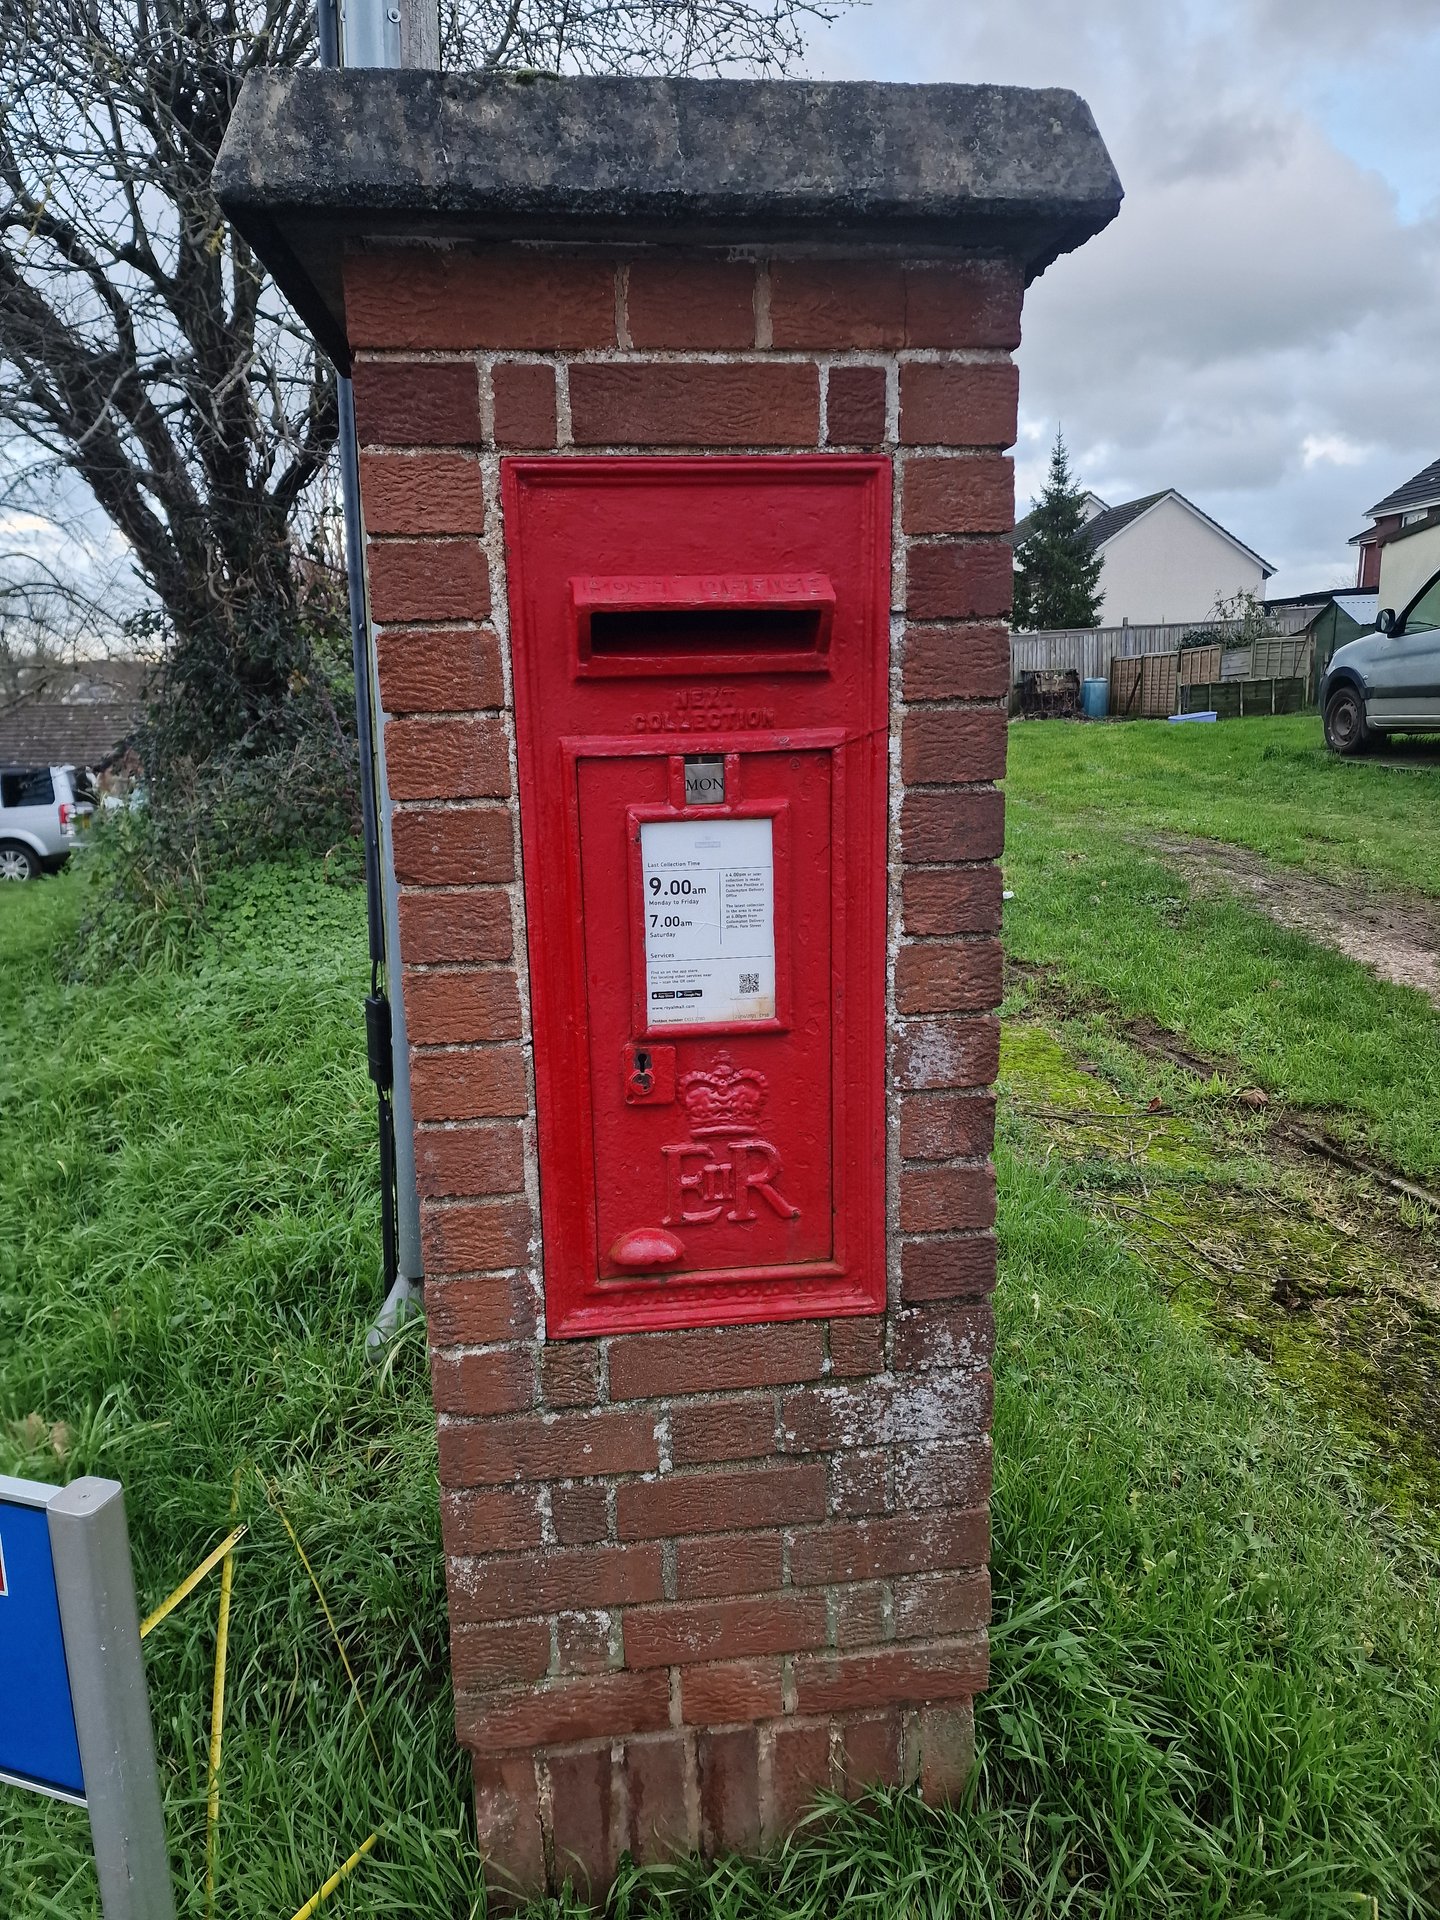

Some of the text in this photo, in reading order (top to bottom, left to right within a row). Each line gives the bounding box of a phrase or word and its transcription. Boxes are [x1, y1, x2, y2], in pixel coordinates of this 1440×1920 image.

[583, 573, 821, 597] POST OFFICE
[673, 686, 737, 711] NEXT
[631, 706, 775, 732] COLLECTION
[686, 777, 724, 791] MON
[648, 876, 707, 896] 9.00am
[681, 898, 700, 906] Friday
[649, 914, 693, 928] 7.00am
